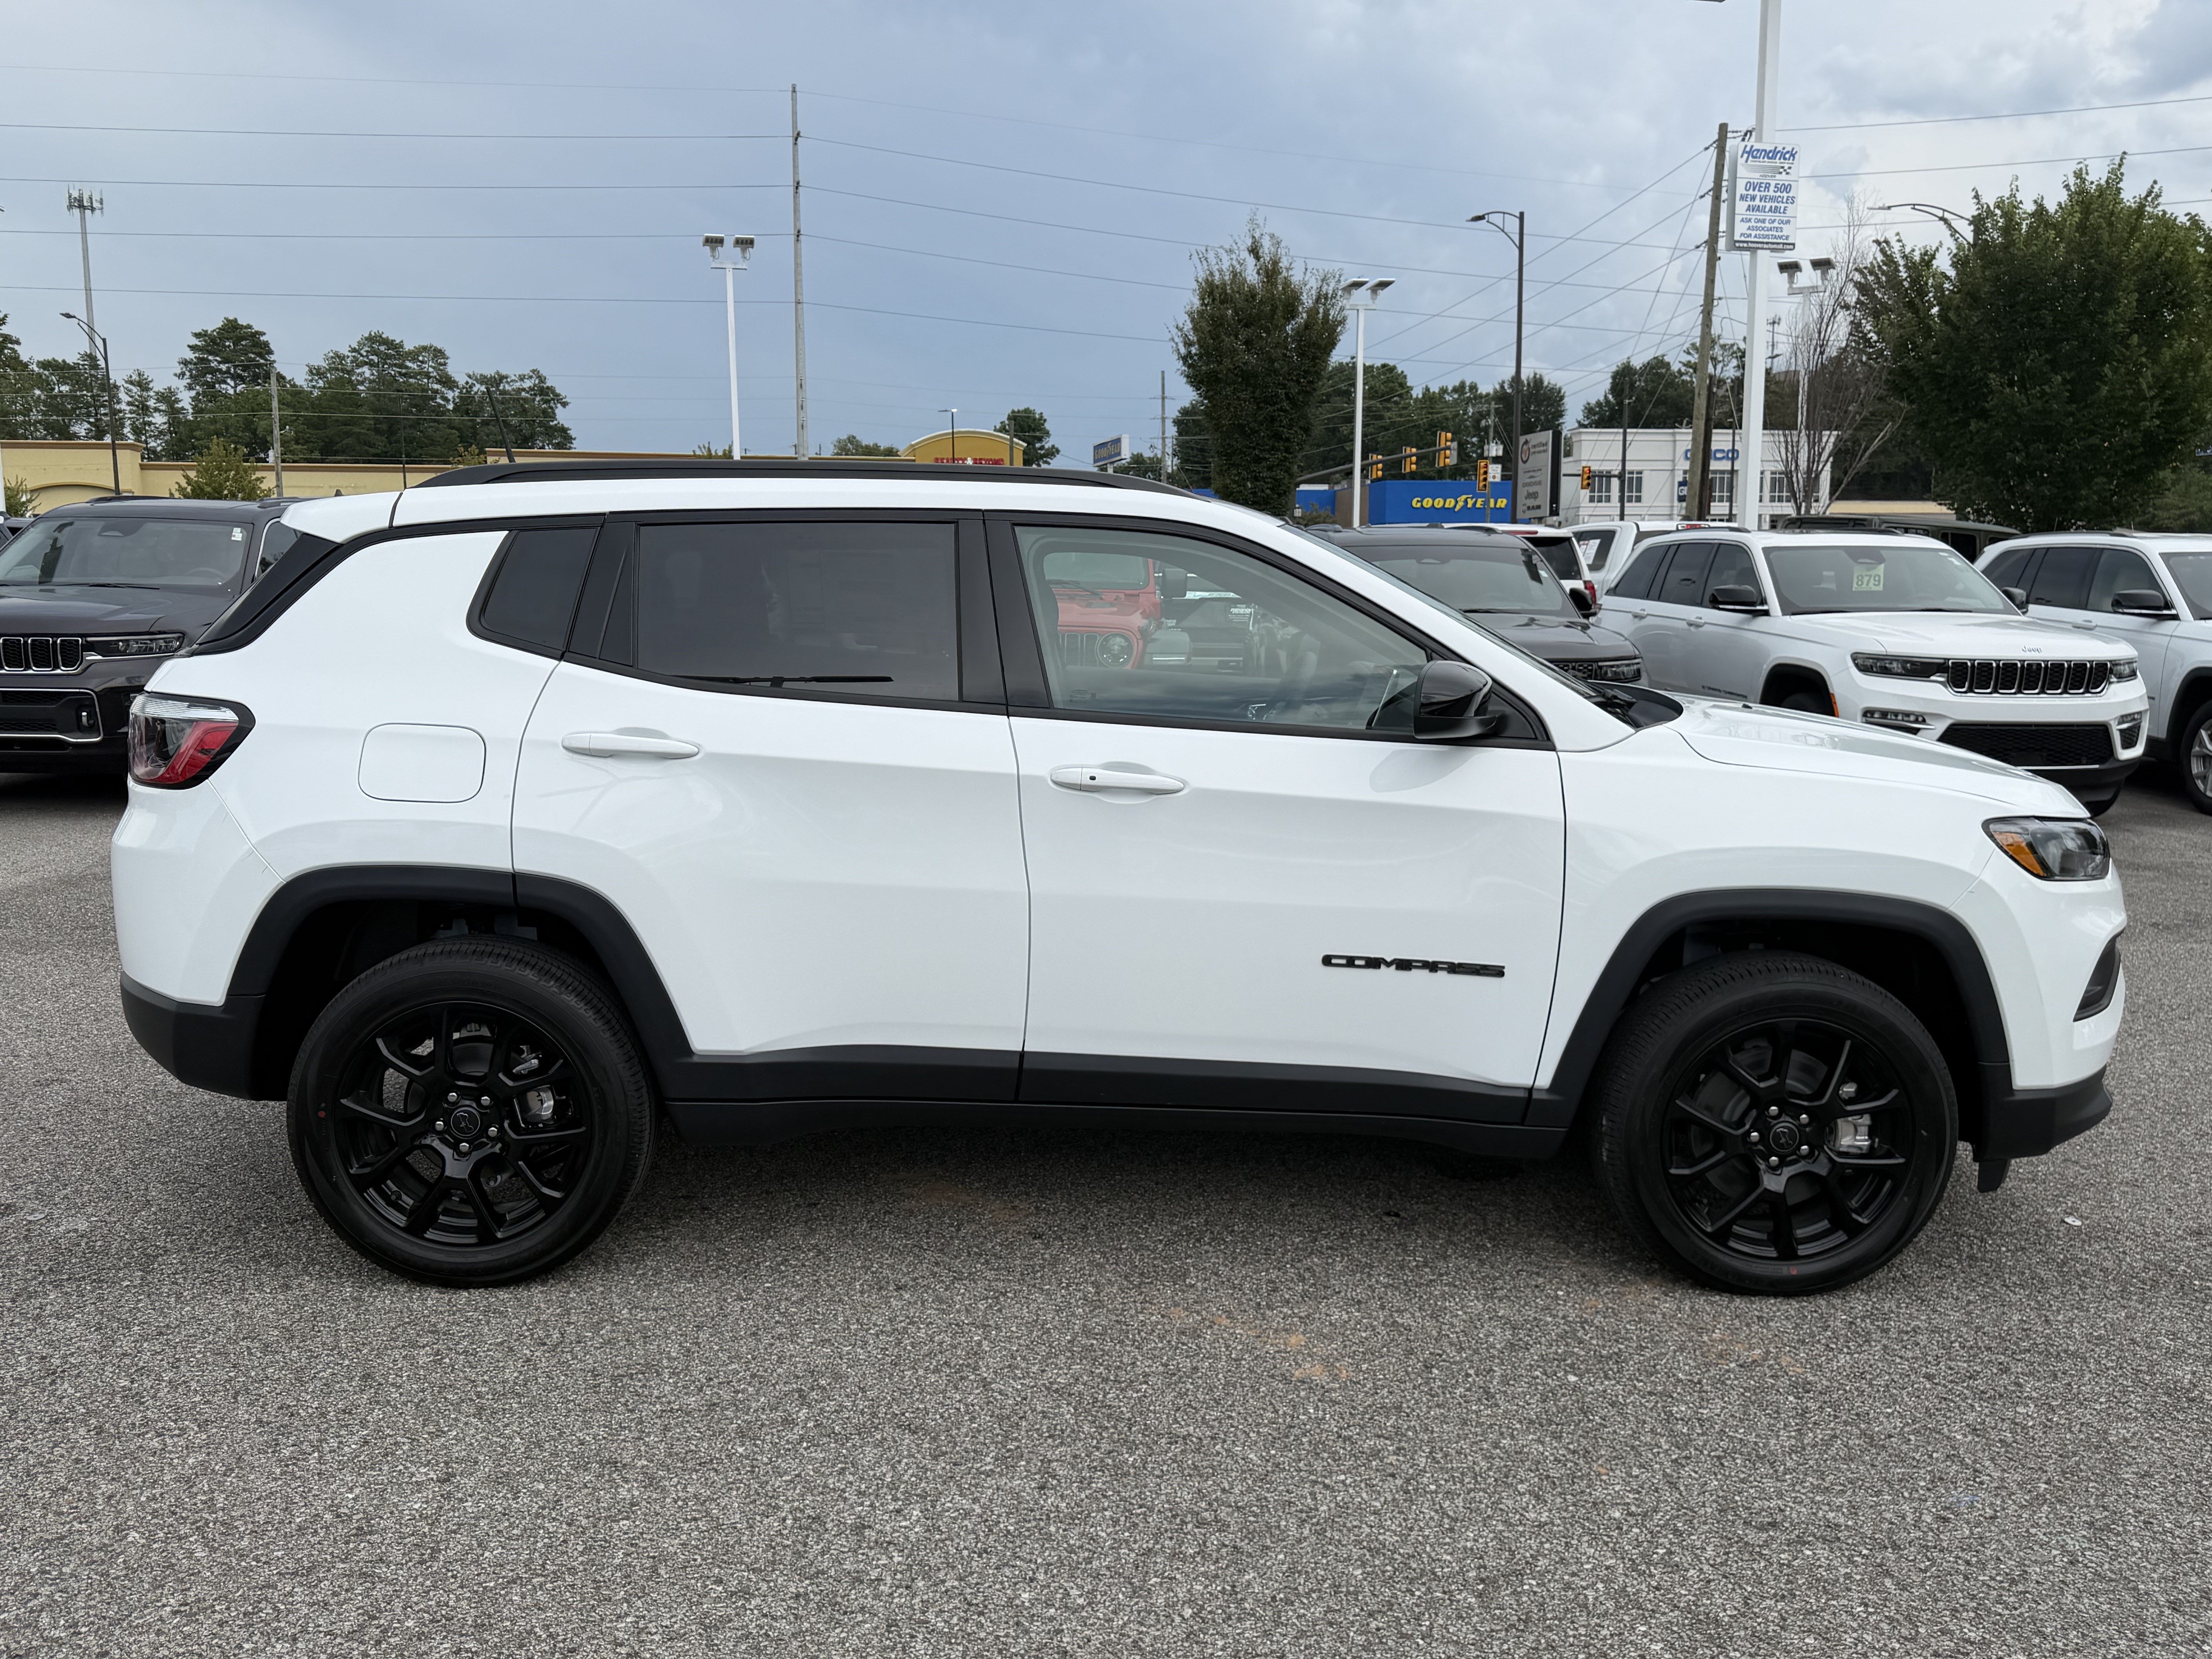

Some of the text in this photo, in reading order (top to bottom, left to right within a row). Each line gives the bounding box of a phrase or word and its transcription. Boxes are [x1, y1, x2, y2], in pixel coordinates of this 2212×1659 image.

[1740, 144, 1798, 163] Hendrick
[1745, 181, 1792, 194] OVER 500
[1739, 193, 1795, 204] NEW VEHICLES
[1745, 204, 1788, 214] AVAILABLE
[1525, 489, 1538, 501] Jeep
[1856, 574, 1881, 587] 879
[1322, 954, 1505, 978] COMPASS
